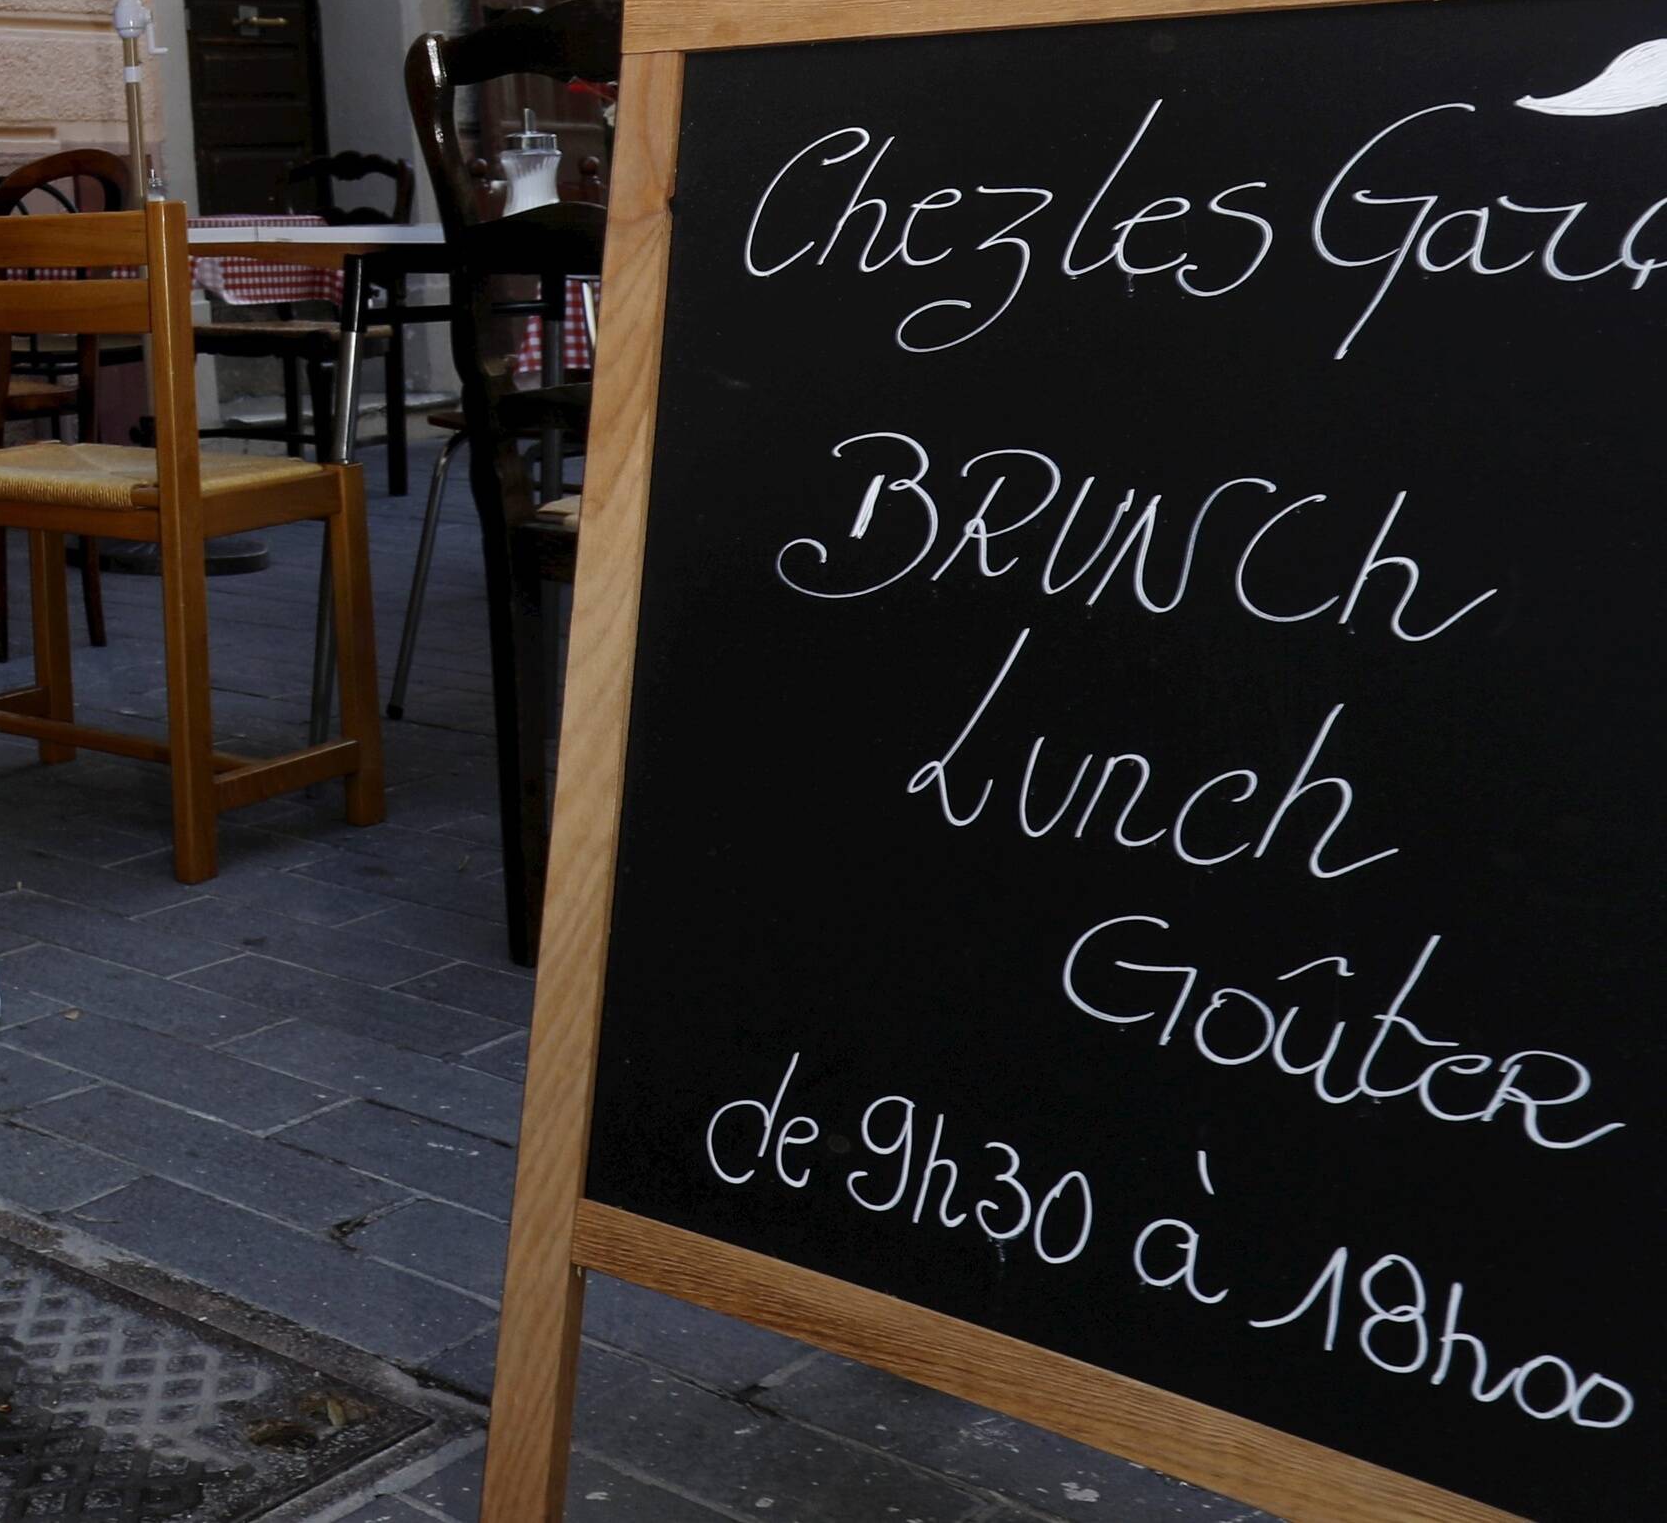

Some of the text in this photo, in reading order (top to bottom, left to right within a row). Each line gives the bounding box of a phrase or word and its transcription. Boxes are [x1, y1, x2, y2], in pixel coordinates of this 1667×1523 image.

[743, 127, 1055, 354] Chez
[907, 627, 1400, 879] Lunch
[706, 1051, 820, 1188] de
[846, 1095, 1094, 1265] 9h30
[1134, 1149, 1230, 1304] à
